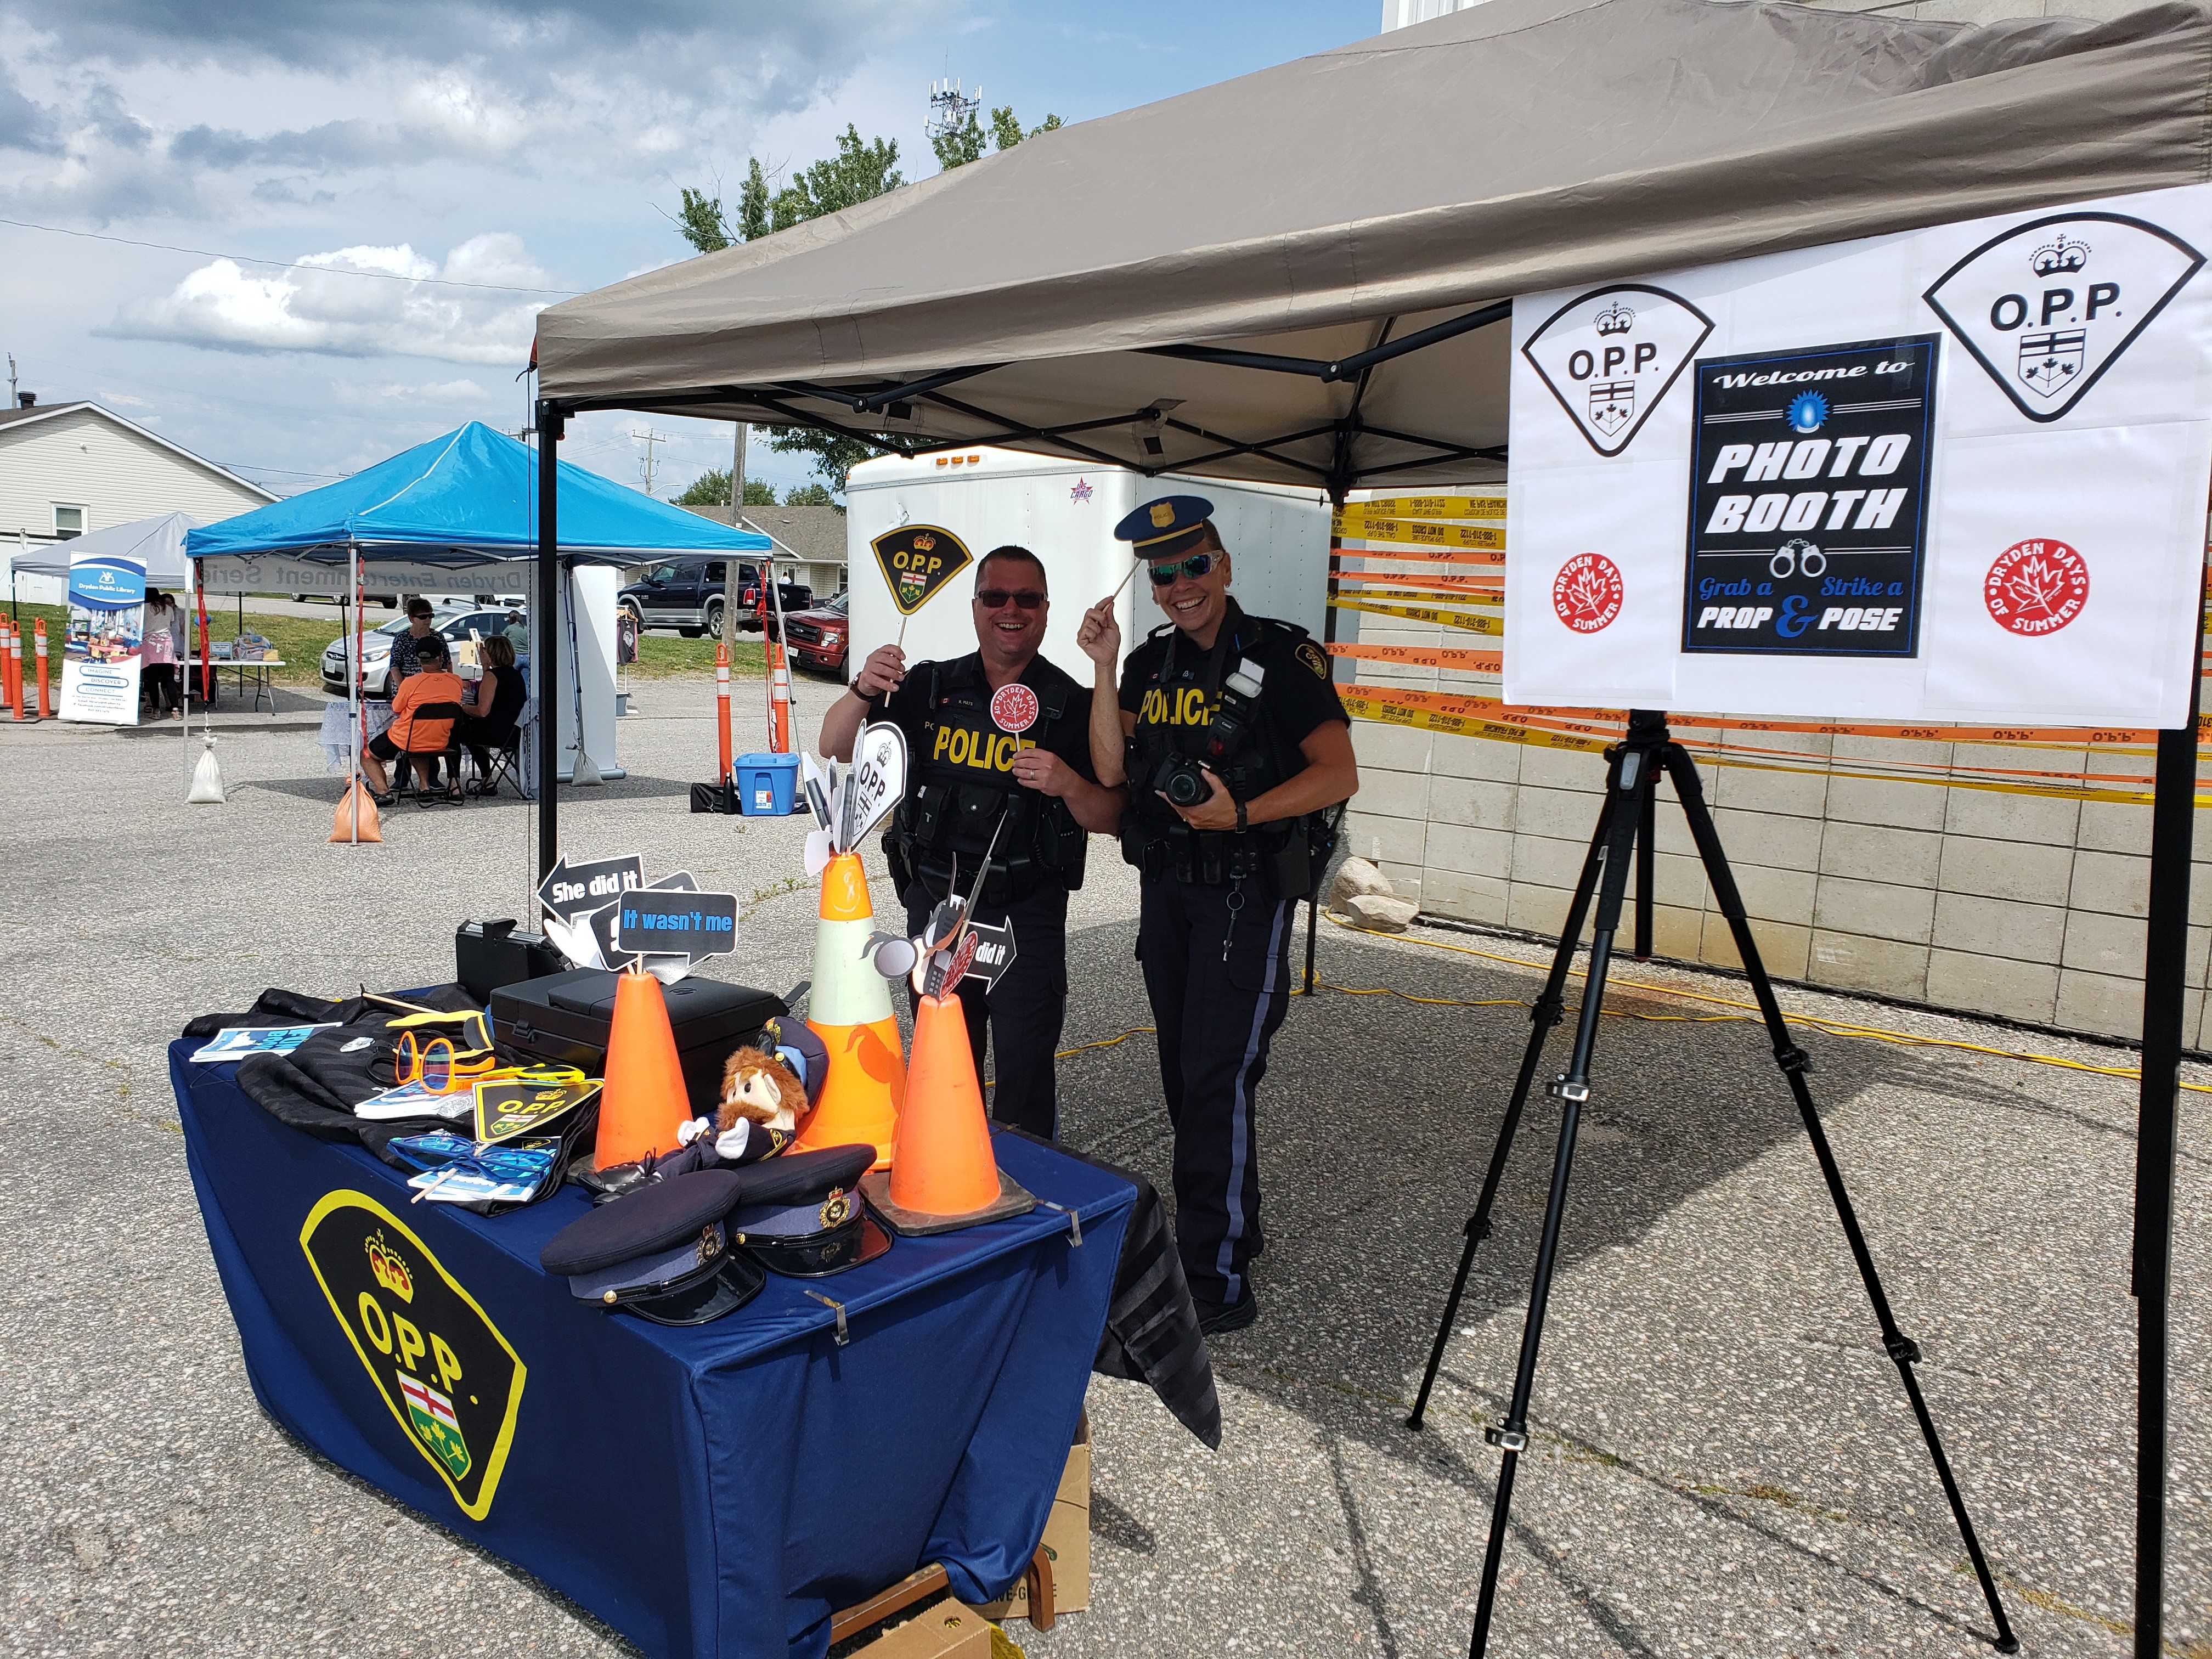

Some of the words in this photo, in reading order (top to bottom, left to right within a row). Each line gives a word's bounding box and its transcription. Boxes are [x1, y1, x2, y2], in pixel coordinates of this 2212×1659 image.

[1990, 282, 2122, 331] O.P.P.
[1568, 342, 1659, 381] O.P.P.
[1713, 364, 1868, 389] Welcome
[1875, 360, 1916, 375] to
[1706, 434, 1911, 484] PHOTO
[1070, 489, 1093, 499] CARGO
[1704, 487, 1909, 534] BOOTH
[1364, 521, 1398, 532] 1-888-310-1122
[1460, 529, 1497, 541] 1-888-310-1122
[893, 551, 942, 576] O.P.P.
[1555, 556, 1592, 592] DRYDEN
[1598, 560, 1621, 591] DAYS
[1989, 542, 2044, 586] DRYDEN
[2053, 546, 2086, 586] DAYS
[116, 586, 136, 594] Library
[1699, 577, 1752, 600] Grab
[1756, 582, 1774, 596] a
[1820, 577, 1884, 596] Strike
[1886, 582, 1904, 596] a
[1454, 615, 1491, 629] 1-888-310-1122
[1557, 602, 1571, 617] OF
[1572, 602, 1619, 630] SUMMER
[1696, 607, 1774, 629] PROP
[1775, 595, 1819, 638] &
[1817, 607, 1904, 631] POSE
[1990, 598, 2010, 616] OF
[2012, 599, 2081, 632] SUMMER
[1473, 661, 1500, 671] O.P.P.
[997, 687, 1025, 701] DRYDEN
[1026, 695, 1036, 716] DAYS
[1381, 705, 1397, 715] CROSS
[1397, 708, 1406, 717] NOT
[994, 706, 1001, 715] OF
[999, 718, 1029, 729] SUMMER
[1407, 709, 1414, 718] DO
[1429, 714, 1465, 727] 1-888-310-1122
[1501, 713, 1528, 723] O.P.P.
[1198, 760, 1211, 769] Canon
[860, 761, 885, 807] O.P.P.
[552, 881, 586, 904] She
[589, 871, 620, 896] did
[621, 870, 638, 890] it
[623, 910, 638, 929] It
[642, 911, 702, 931] wasn't
[705, 915, 733, 932] me
[975, 941, 997, 964] did
[994, 945, 1006, 966] it
[274, 1027, 315, 1050] FUN
[497, 1099, 566, 1114] O.P.P.
[358, 1291, 479, 1405] O.P.P.
